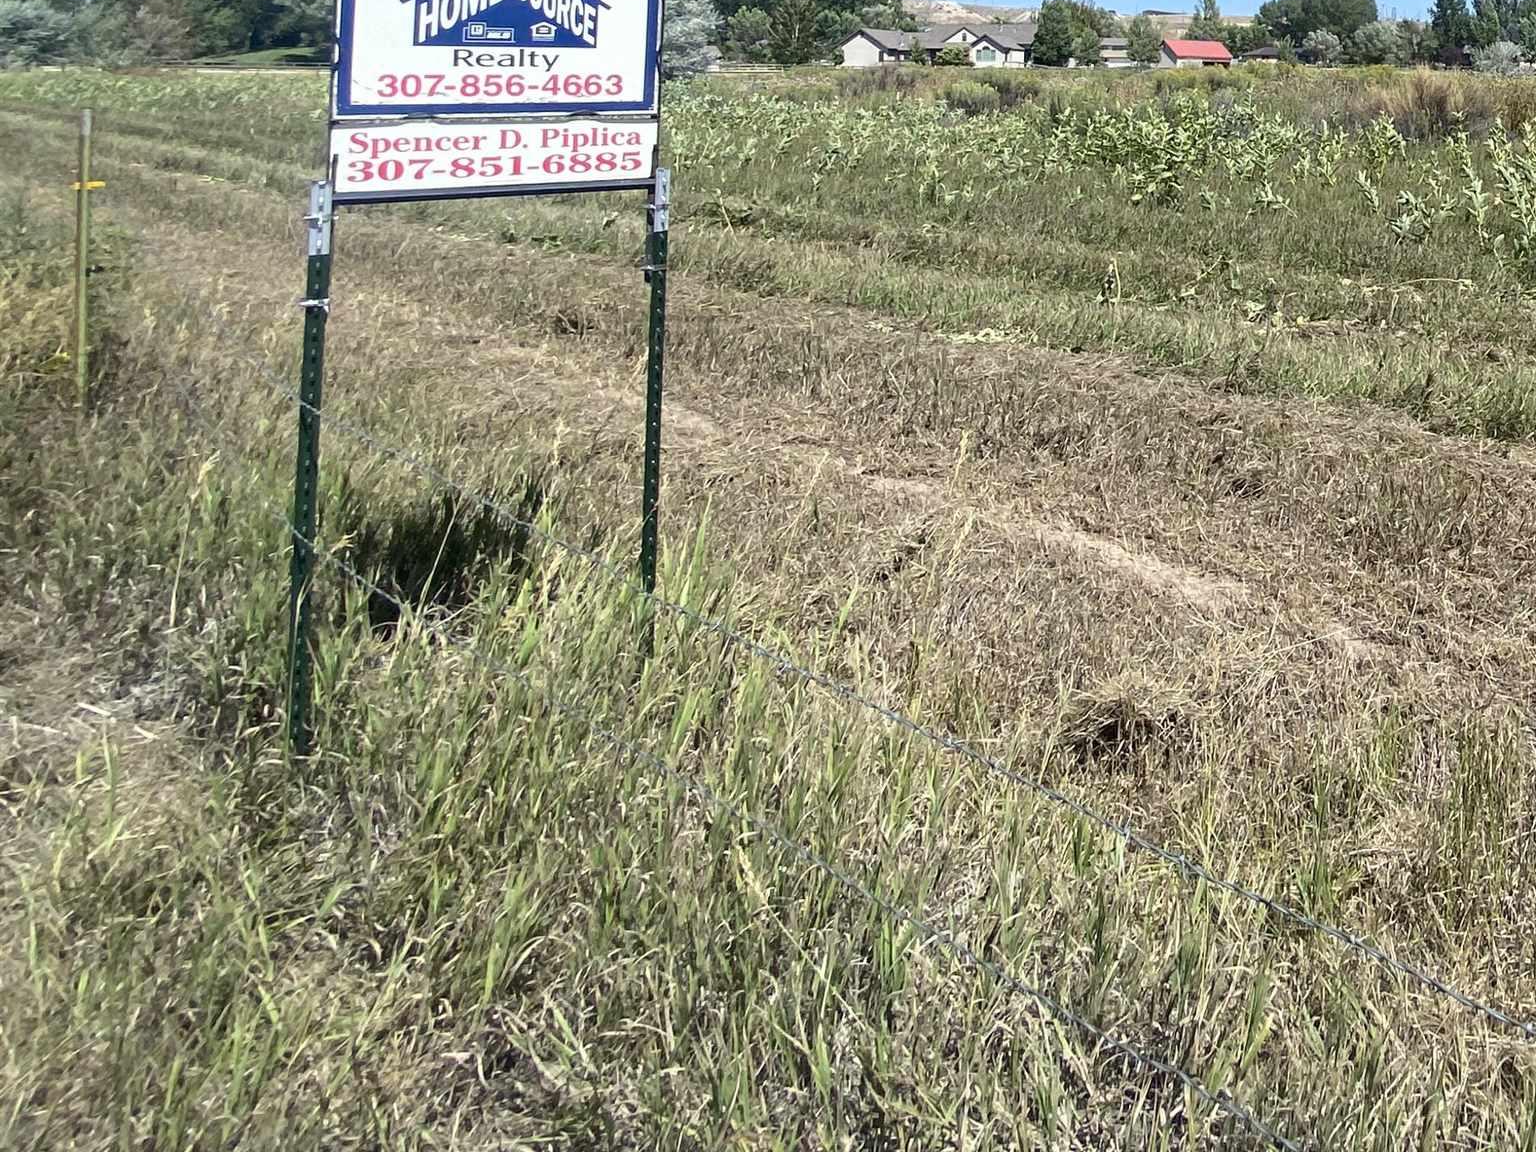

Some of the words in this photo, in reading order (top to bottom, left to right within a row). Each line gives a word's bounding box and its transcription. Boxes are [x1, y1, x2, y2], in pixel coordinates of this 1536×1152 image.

[453, 49, 560, 72] Realty
[377, 74, 624, 98] 307-856-4663
[348, 133, 487, 160] Spencer
[499, 131, 528, 149] D.
[541, 127, 642, 155] Piplica
[347, 151, 643, 183] 307-851-6885
